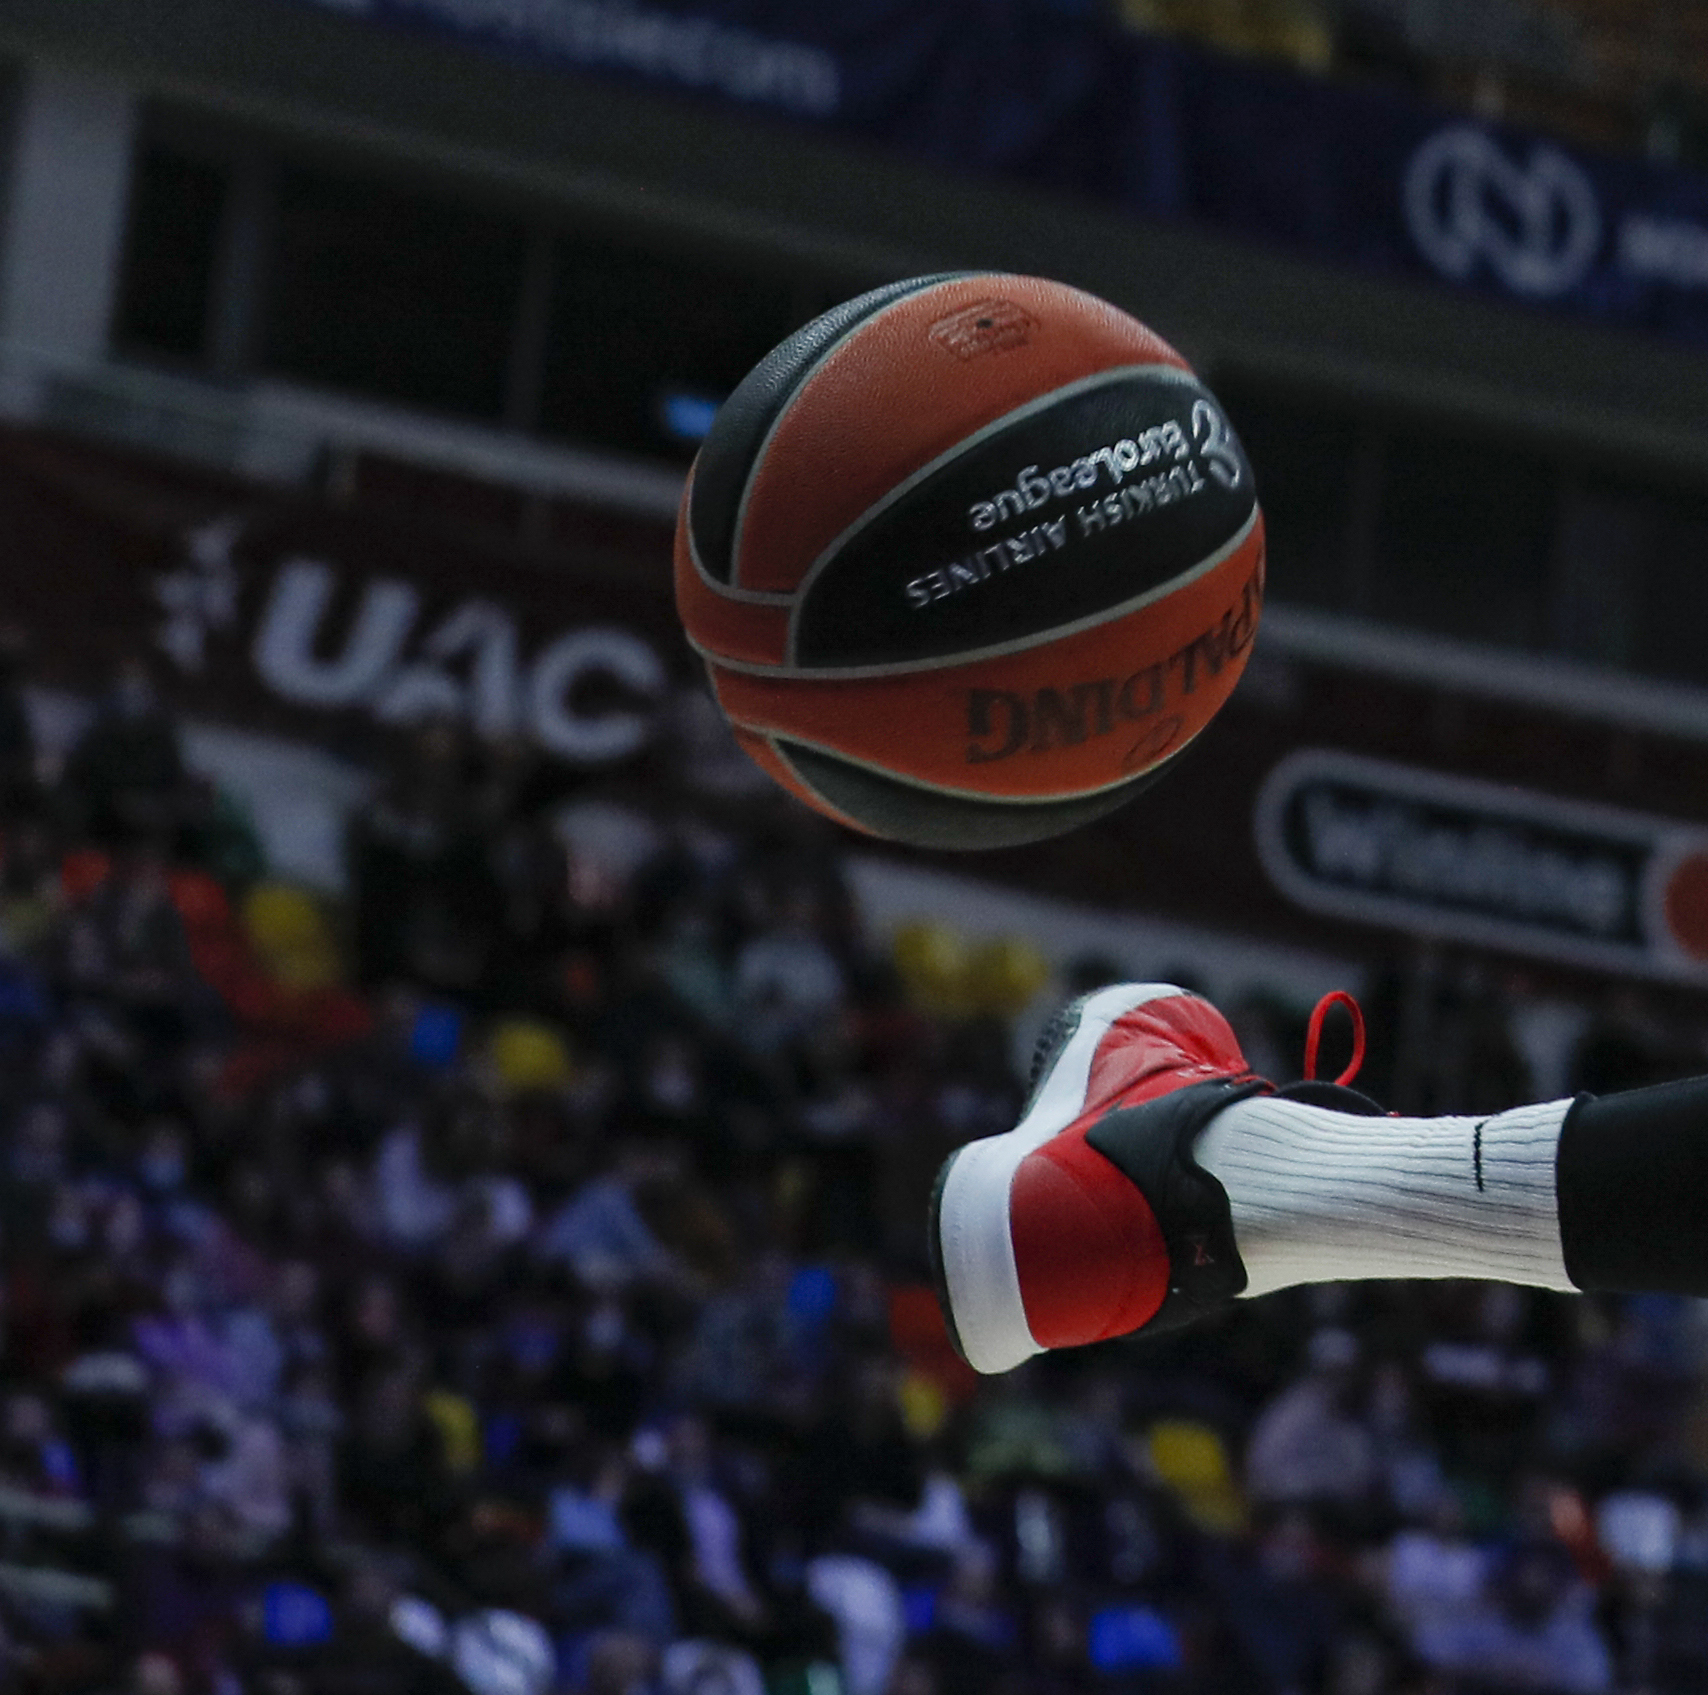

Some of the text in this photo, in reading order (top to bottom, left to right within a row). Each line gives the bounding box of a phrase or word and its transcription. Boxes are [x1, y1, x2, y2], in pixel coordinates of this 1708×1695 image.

[906, 460, 1205, 608] TURKISH AIRLINES
[968, 419, 1188, 531] EuroLeague
[250, 557, 666, 763] UAC
[967, 555, 1264, 763] PALDING
